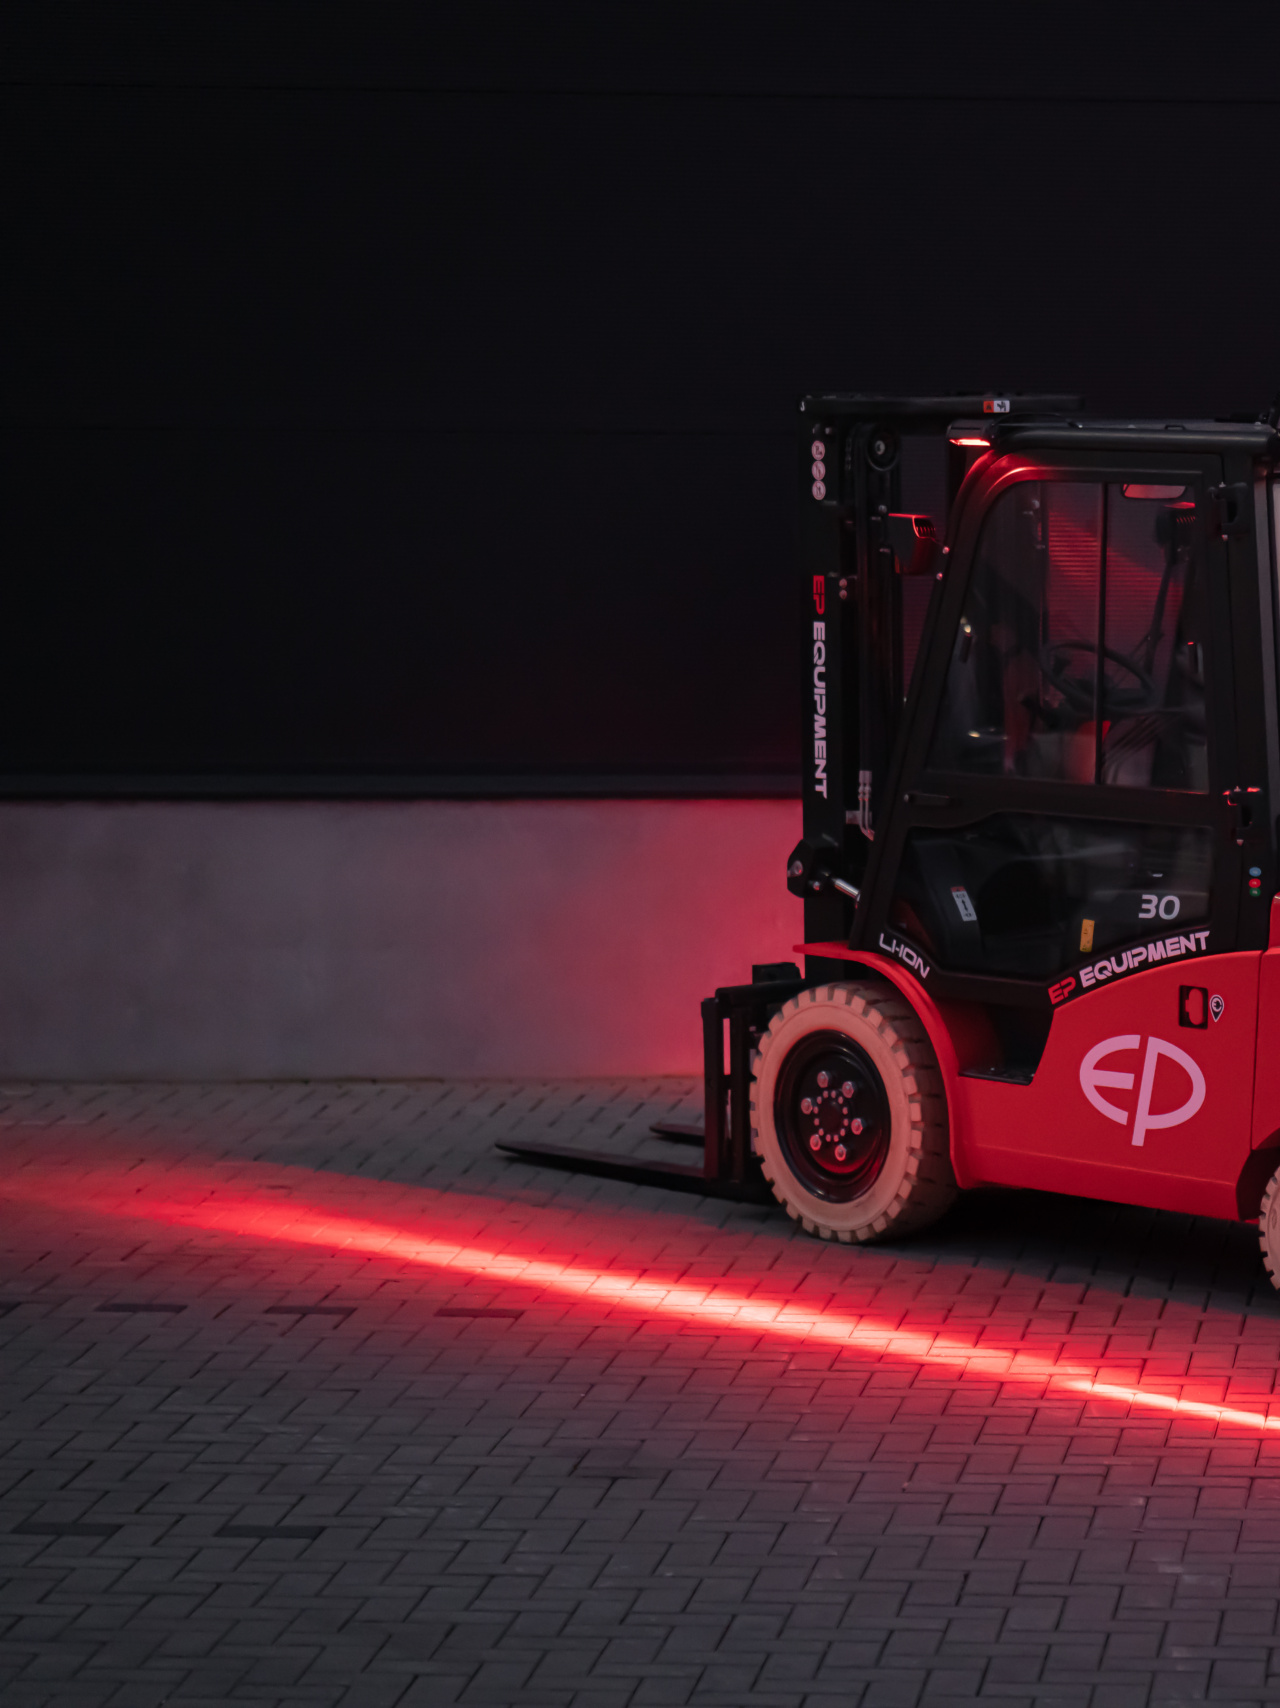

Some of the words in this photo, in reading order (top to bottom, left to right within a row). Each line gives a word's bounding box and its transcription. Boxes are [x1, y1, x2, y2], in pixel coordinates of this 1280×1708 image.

[813, 575, 825, 615] EP
[813, 621, 827, 799] EQUIPMENT
[1138, 894, 1181, 920] 30
[879, 933, 930, 978] LI-ION
[1048, 976, 1076, 1005] EP
[1079, 931, 1210, 988] EQUIPMENT
[1079, 1034, 1206, 1147] EP
